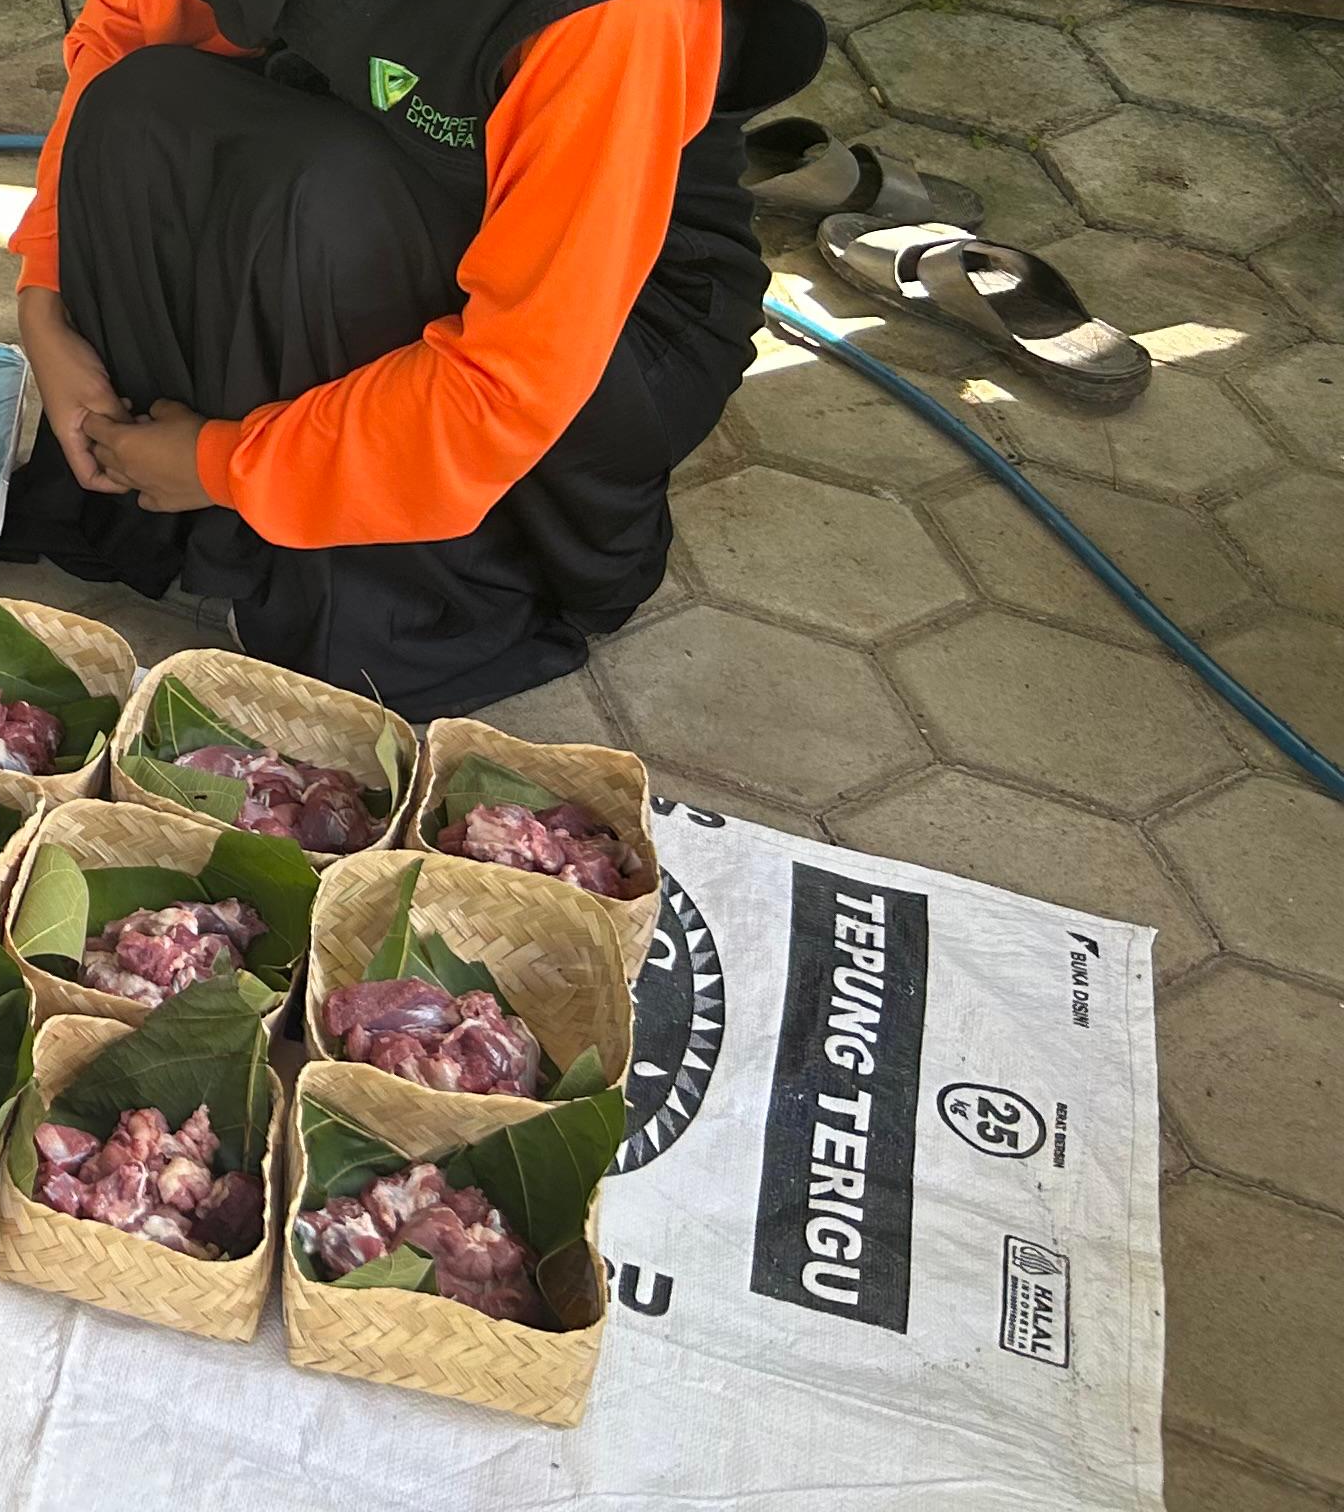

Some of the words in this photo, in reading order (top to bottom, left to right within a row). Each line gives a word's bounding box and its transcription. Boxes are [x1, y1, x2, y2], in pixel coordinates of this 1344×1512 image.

[405, 108, 476, 150] DHUAFA
[411, 95, 478, 132] DOMPET
[823, 892, 886, 1076] TEPUNG
[1070, 951, 1089, 987] BUKA
[1071, 989, 1090, 1029] DISINI
[976, 1095, 1021, 1151] 25
[800, 1090, 872, 1307] TERIGU
[1019, 1279, 1030, 1350] INDONESIA
[1030, 1283, 1054, 1355] HALAL
